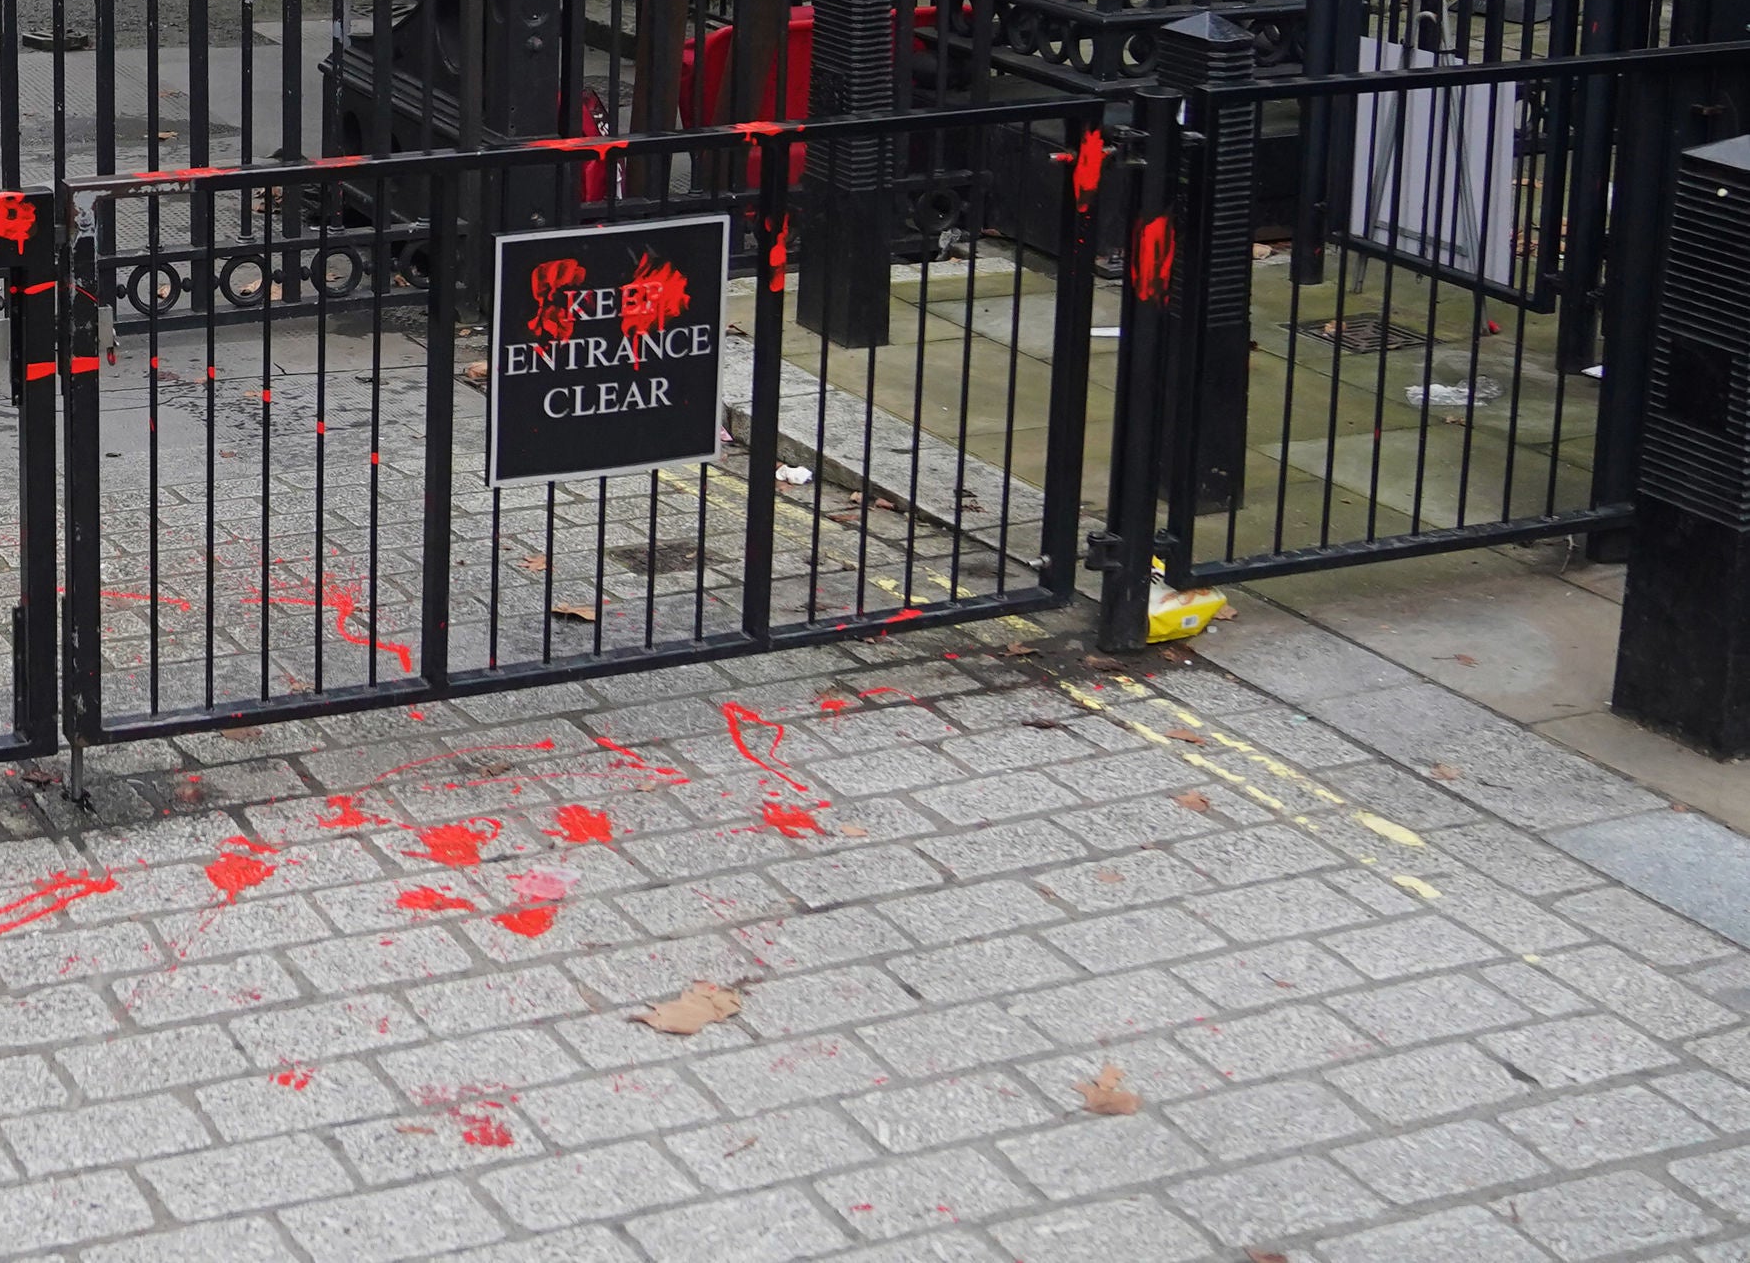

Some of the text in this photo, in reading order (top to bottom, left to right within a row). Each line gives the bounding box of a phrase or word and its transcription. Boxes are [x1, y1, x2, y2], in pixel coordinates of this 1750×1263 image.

[563, 280, 664, 321] KEEP
[504, 324, 712, 376] ENTRANCE
[543, 376, 672, 419] CLEAR
